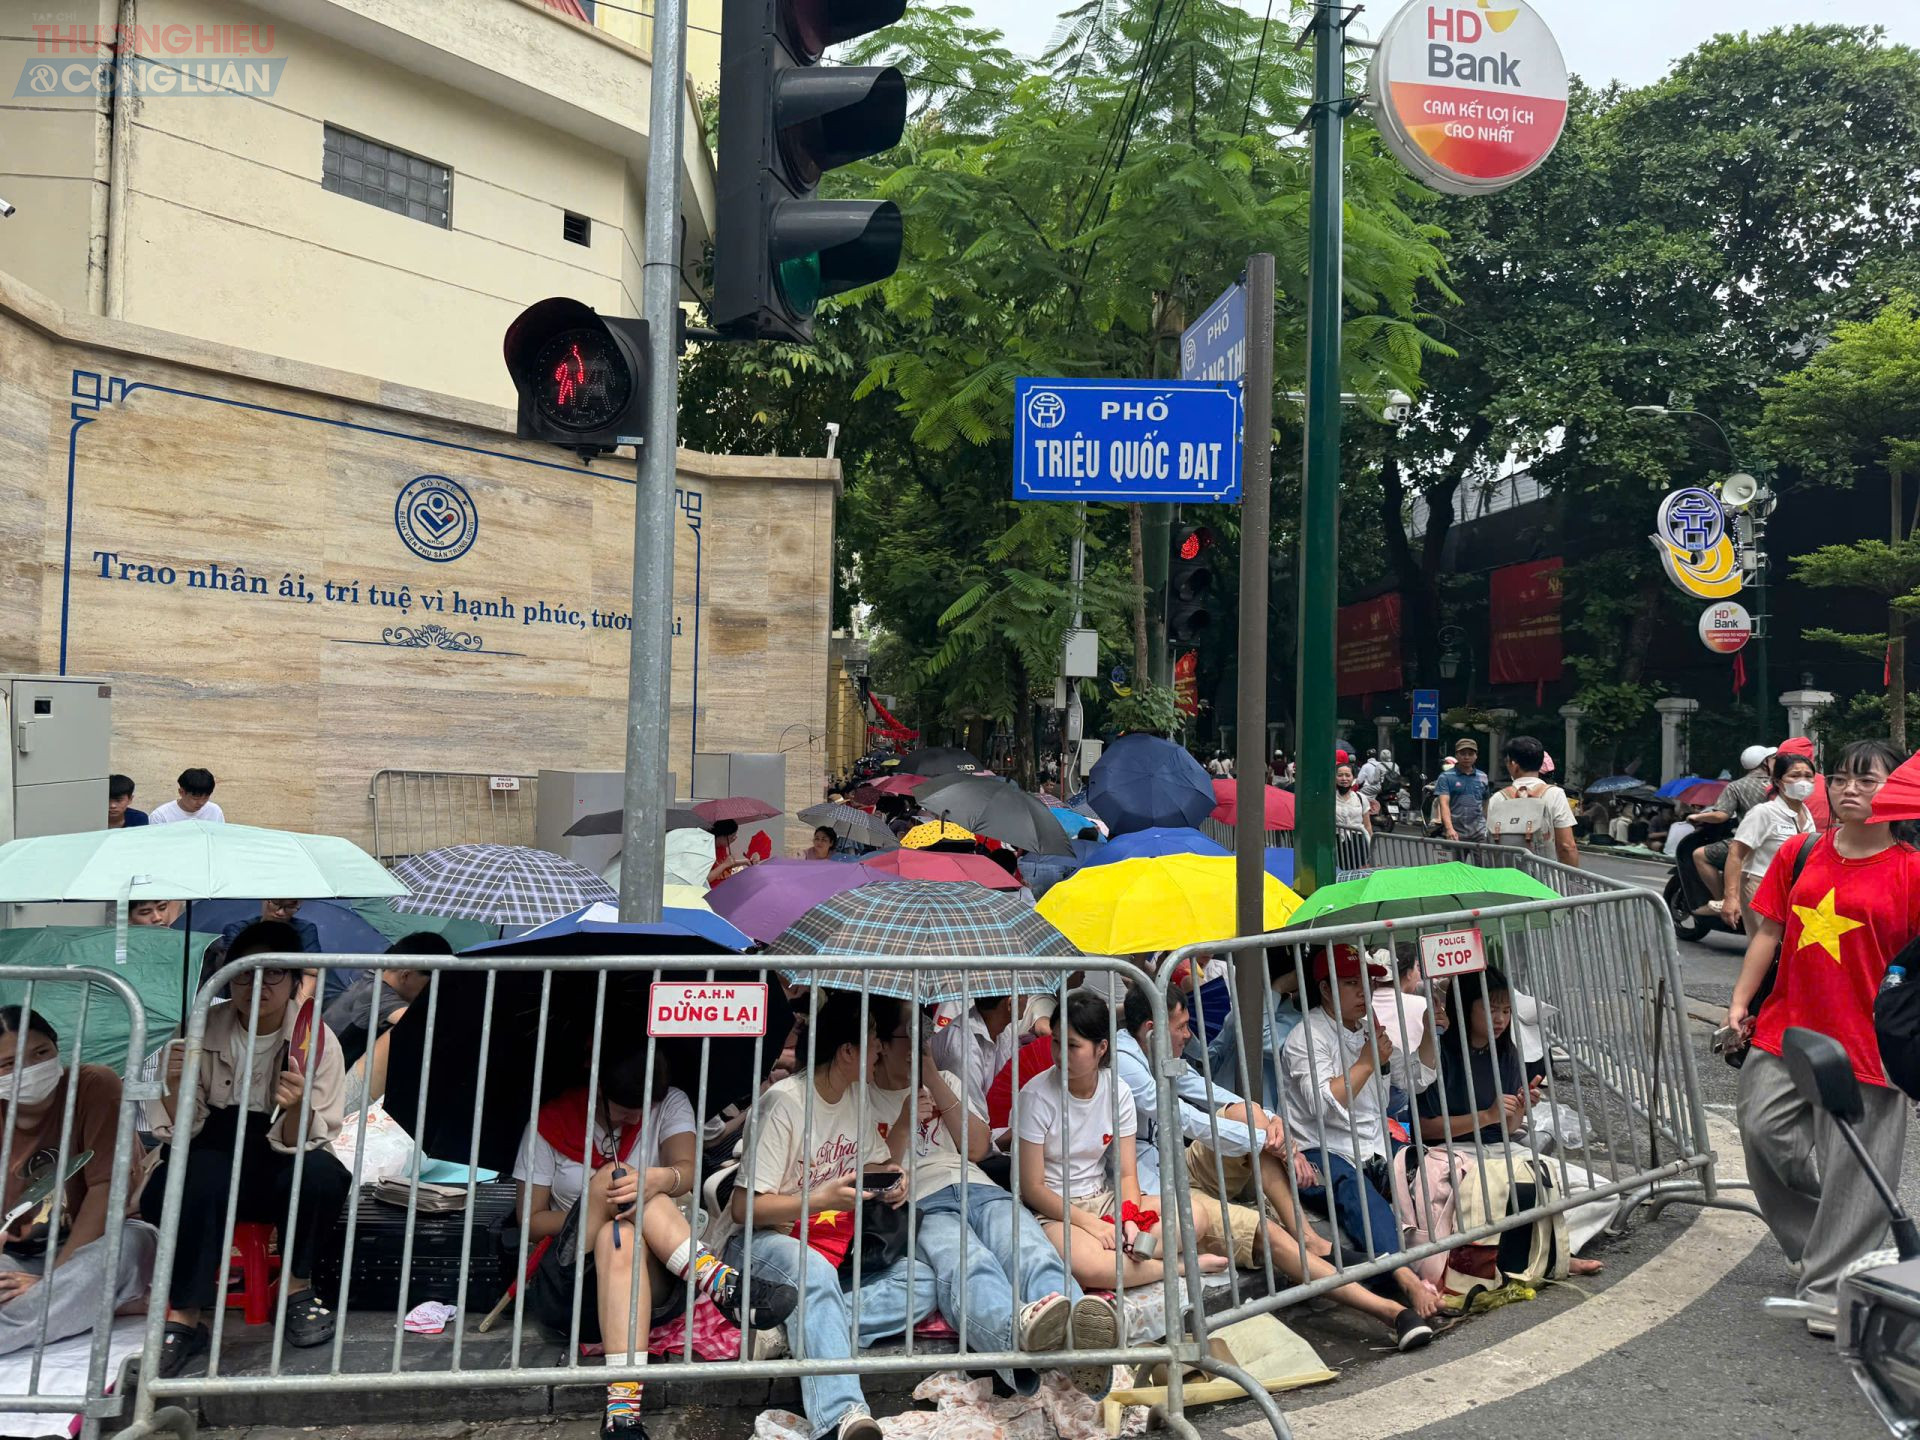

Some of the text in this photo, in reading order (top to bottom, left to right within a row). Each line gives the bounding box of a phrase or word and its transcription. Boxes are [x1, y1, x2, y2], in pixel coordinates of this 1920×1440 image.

[1427, 5, 1482, 43] HD
[1428, 43, 1521, 87] Bank
[1423, 100, 1456, 115] CAM
[1459, 99, 1484, 119] KẾT
[1512, 106, 1534, 125] ÍCH
[1444, 123, 1515, 143] CAO NHẤT
[1207, 303, 1230, 346] PHỐ
[1101, 393, 1173, 421] PHỐ
[1034, 430, 1222, 488] TRIỆU QUỐC ĐẠT
[92, 551, 633, 631] Trao nhân ái, trí tuệ vì hạnh phúc, tươ
[1714, 610, 1729, 619] HD
[1714, 619, 1738, 628] Bank
[1438, 936, 1466, 946] POLICE
[1437, 949, 1472, 967] STOP
[683, 989, 735, 999] C.A.H.N
[658, 1001, 758, 1025] DỪNG LẠI
